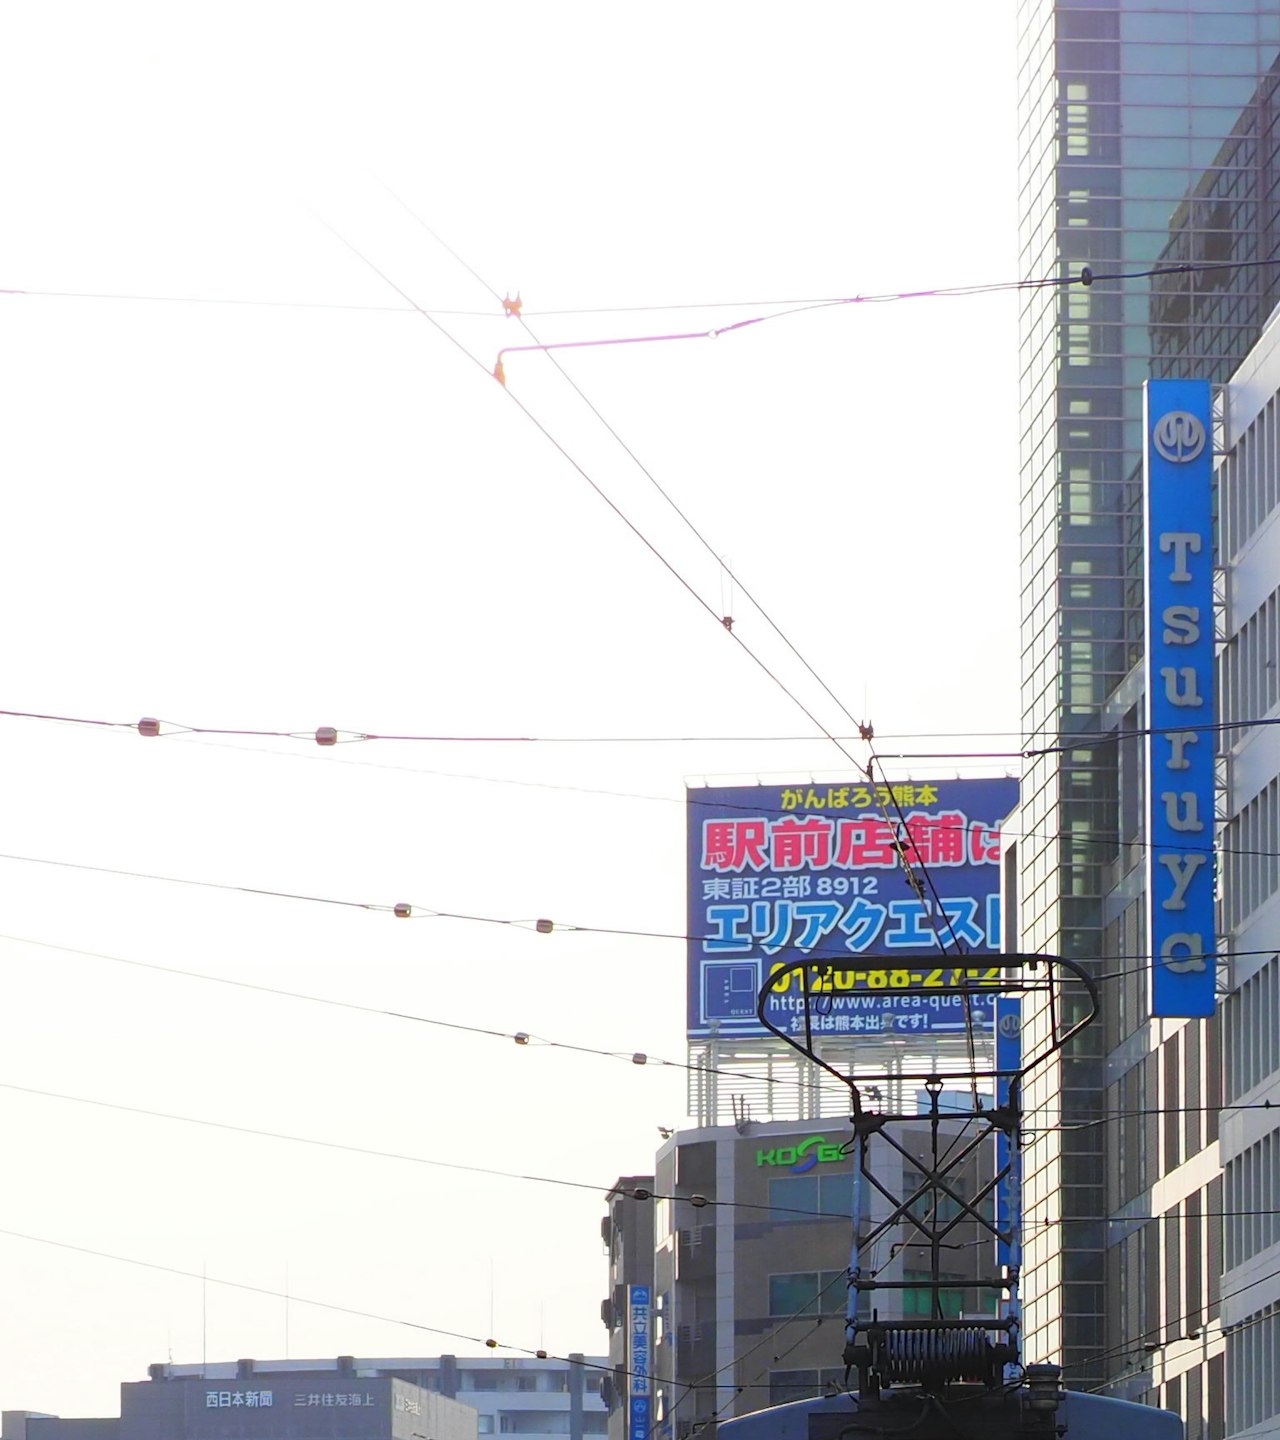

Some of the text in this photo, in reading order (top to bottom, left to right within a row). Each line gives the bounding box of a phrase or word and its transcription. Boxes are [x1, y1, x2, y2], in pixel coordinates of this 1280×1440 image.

[1159, 531, 1206, 974] Tsuruya
[781, 785, 938, 810] がんばろう熊本
[702, 875, 878, 900] 東証2部 8912
[633, 1307, 648, 1393] 共立美容外科
[206, 1391, 375, 1408] 西日本新聞 三井住友海上
